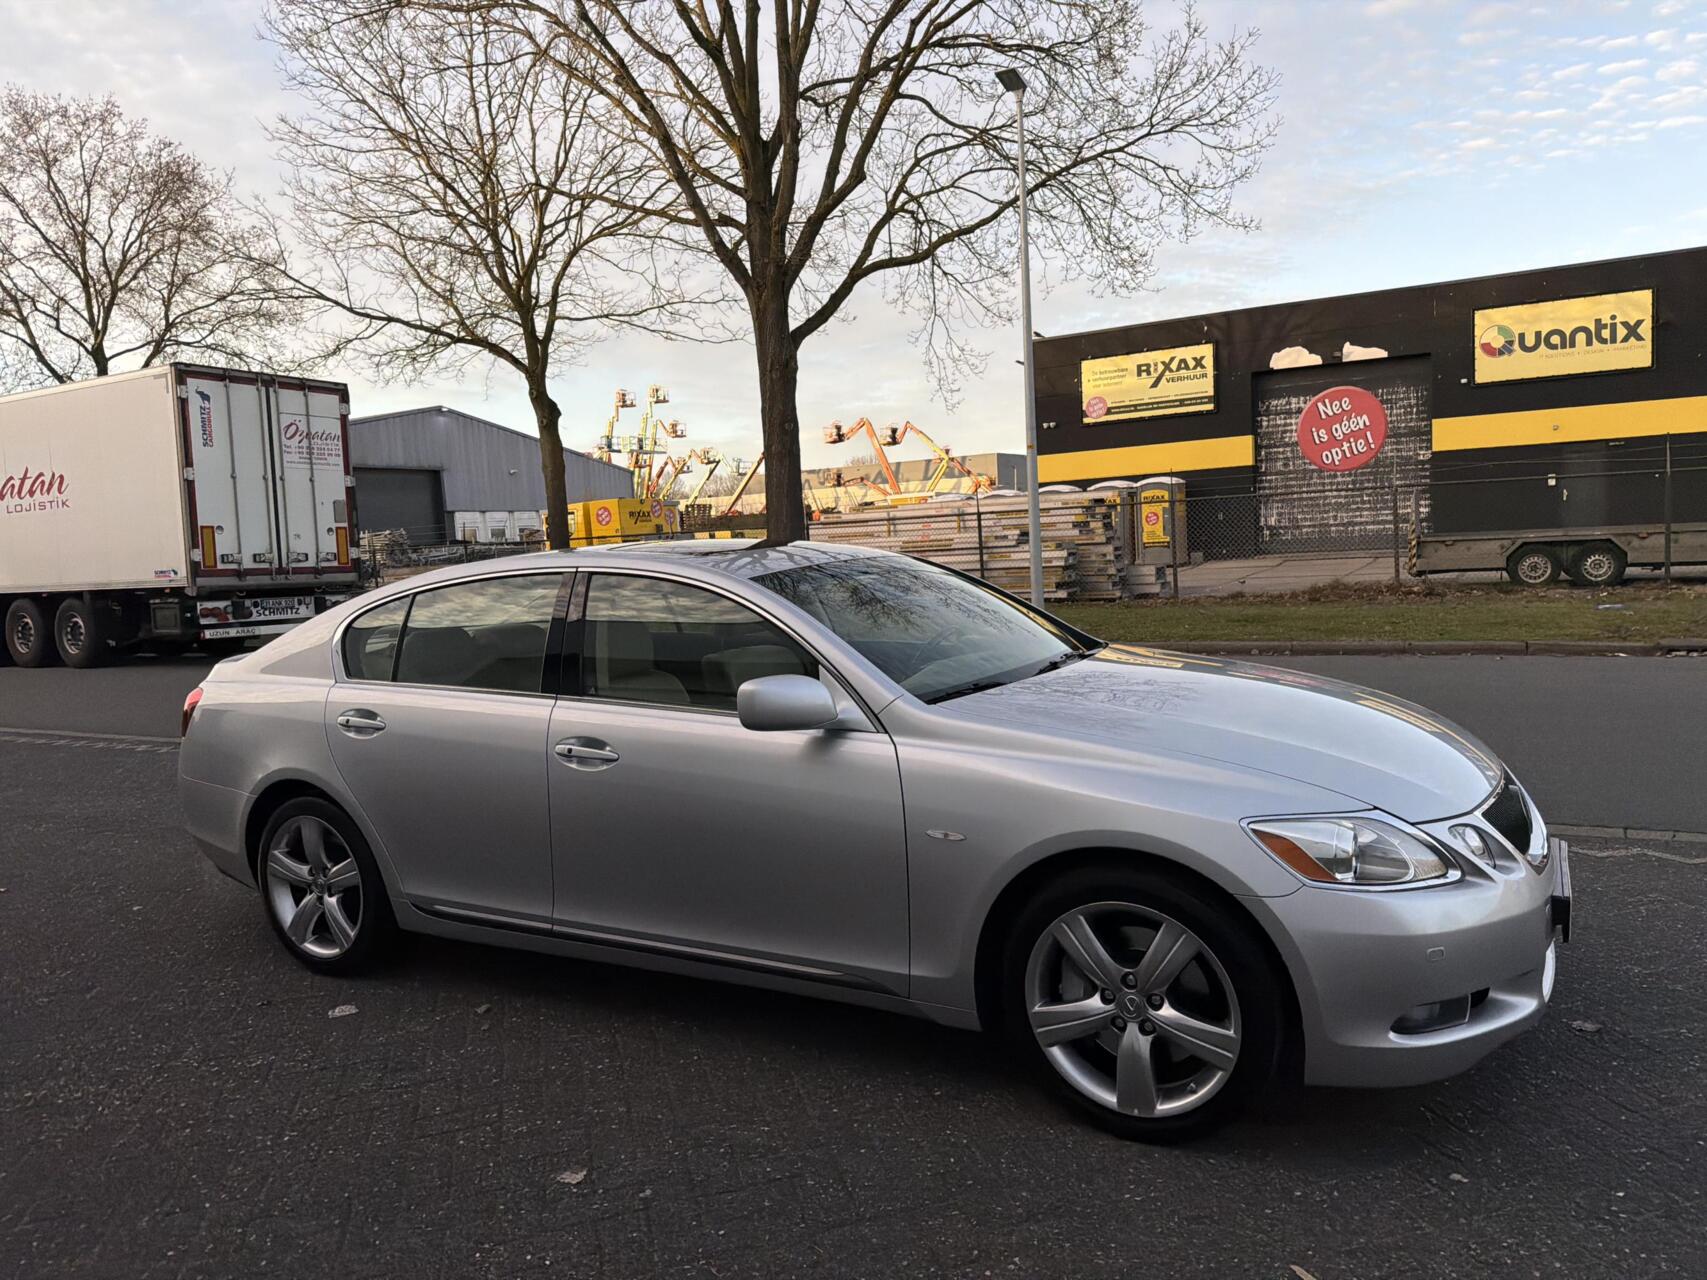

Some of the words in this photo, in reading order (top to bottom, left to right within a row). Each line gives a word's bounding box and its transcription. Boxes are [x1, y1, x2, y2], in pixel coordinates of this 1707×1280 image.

[1480, 314, 1646, 358] Quantix
[1165, 372, 1208, 384] VERHUUR
[1317, 397, 1352, 419] Nee
[200, 405, 208, 447] SCHMITZ
[1312, 427, 1328, 444] is
[1332, 413, 1370, 440] géén
[0, 465, 69, 502] atan
[6, 497, 71, 514] LOJİSTİK
[256, 606, 300, 618] SCHMITZ
